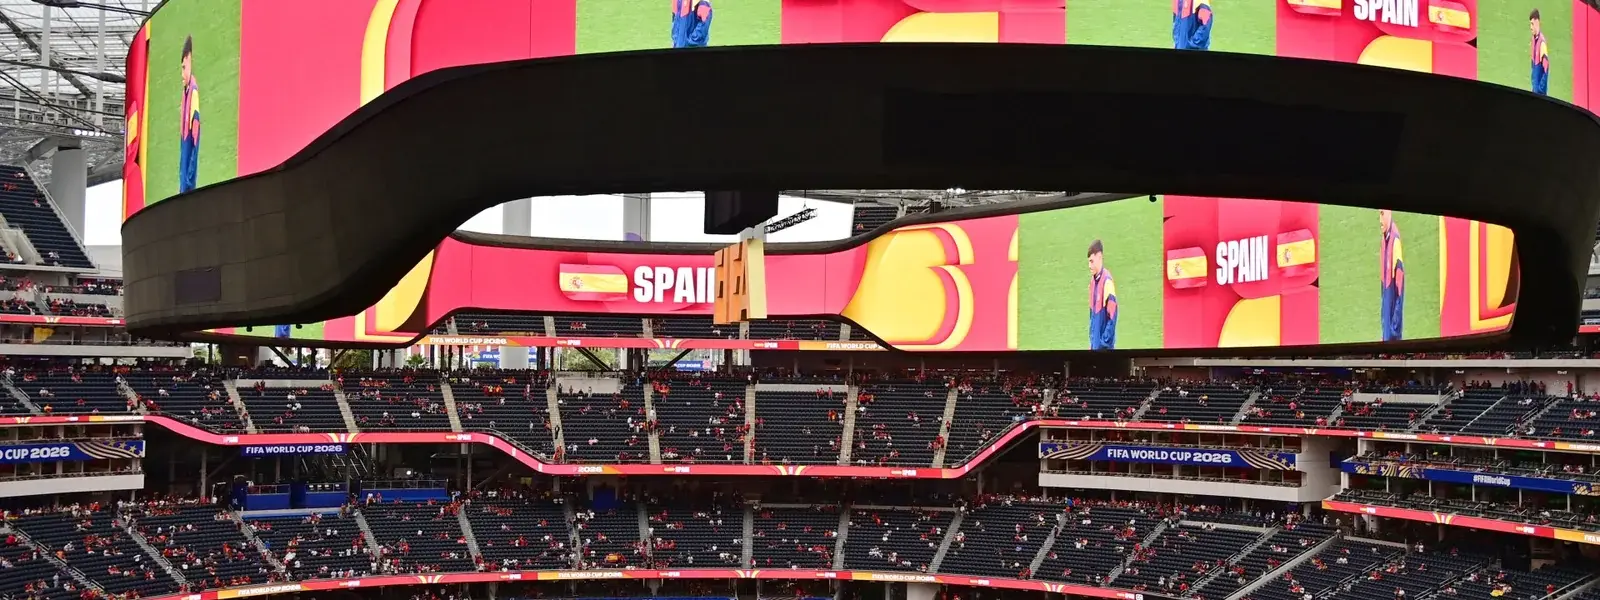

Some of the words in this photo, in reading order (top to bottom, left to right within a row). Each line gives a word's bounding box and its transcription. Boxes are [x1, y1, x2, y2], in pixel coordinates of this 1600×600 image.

[1216, 235, 1269, 286] SPAIN
[5, 448, 29, 460] CUP
[30, 446, 70, 459] 2026
[246, 446, 263, 454] FIFA
[265, 446, 296, 454] WORLD
[297, 444, 314, 453] CUP
[314, 444, 343, 453] 2026
[1107, 448, 1129, 459] FIFA
[1129, 449, 1169, 461] WORLD
[1170, 451, 1192, 461] CUP
[1192, 452, 1232, 463] 2026
